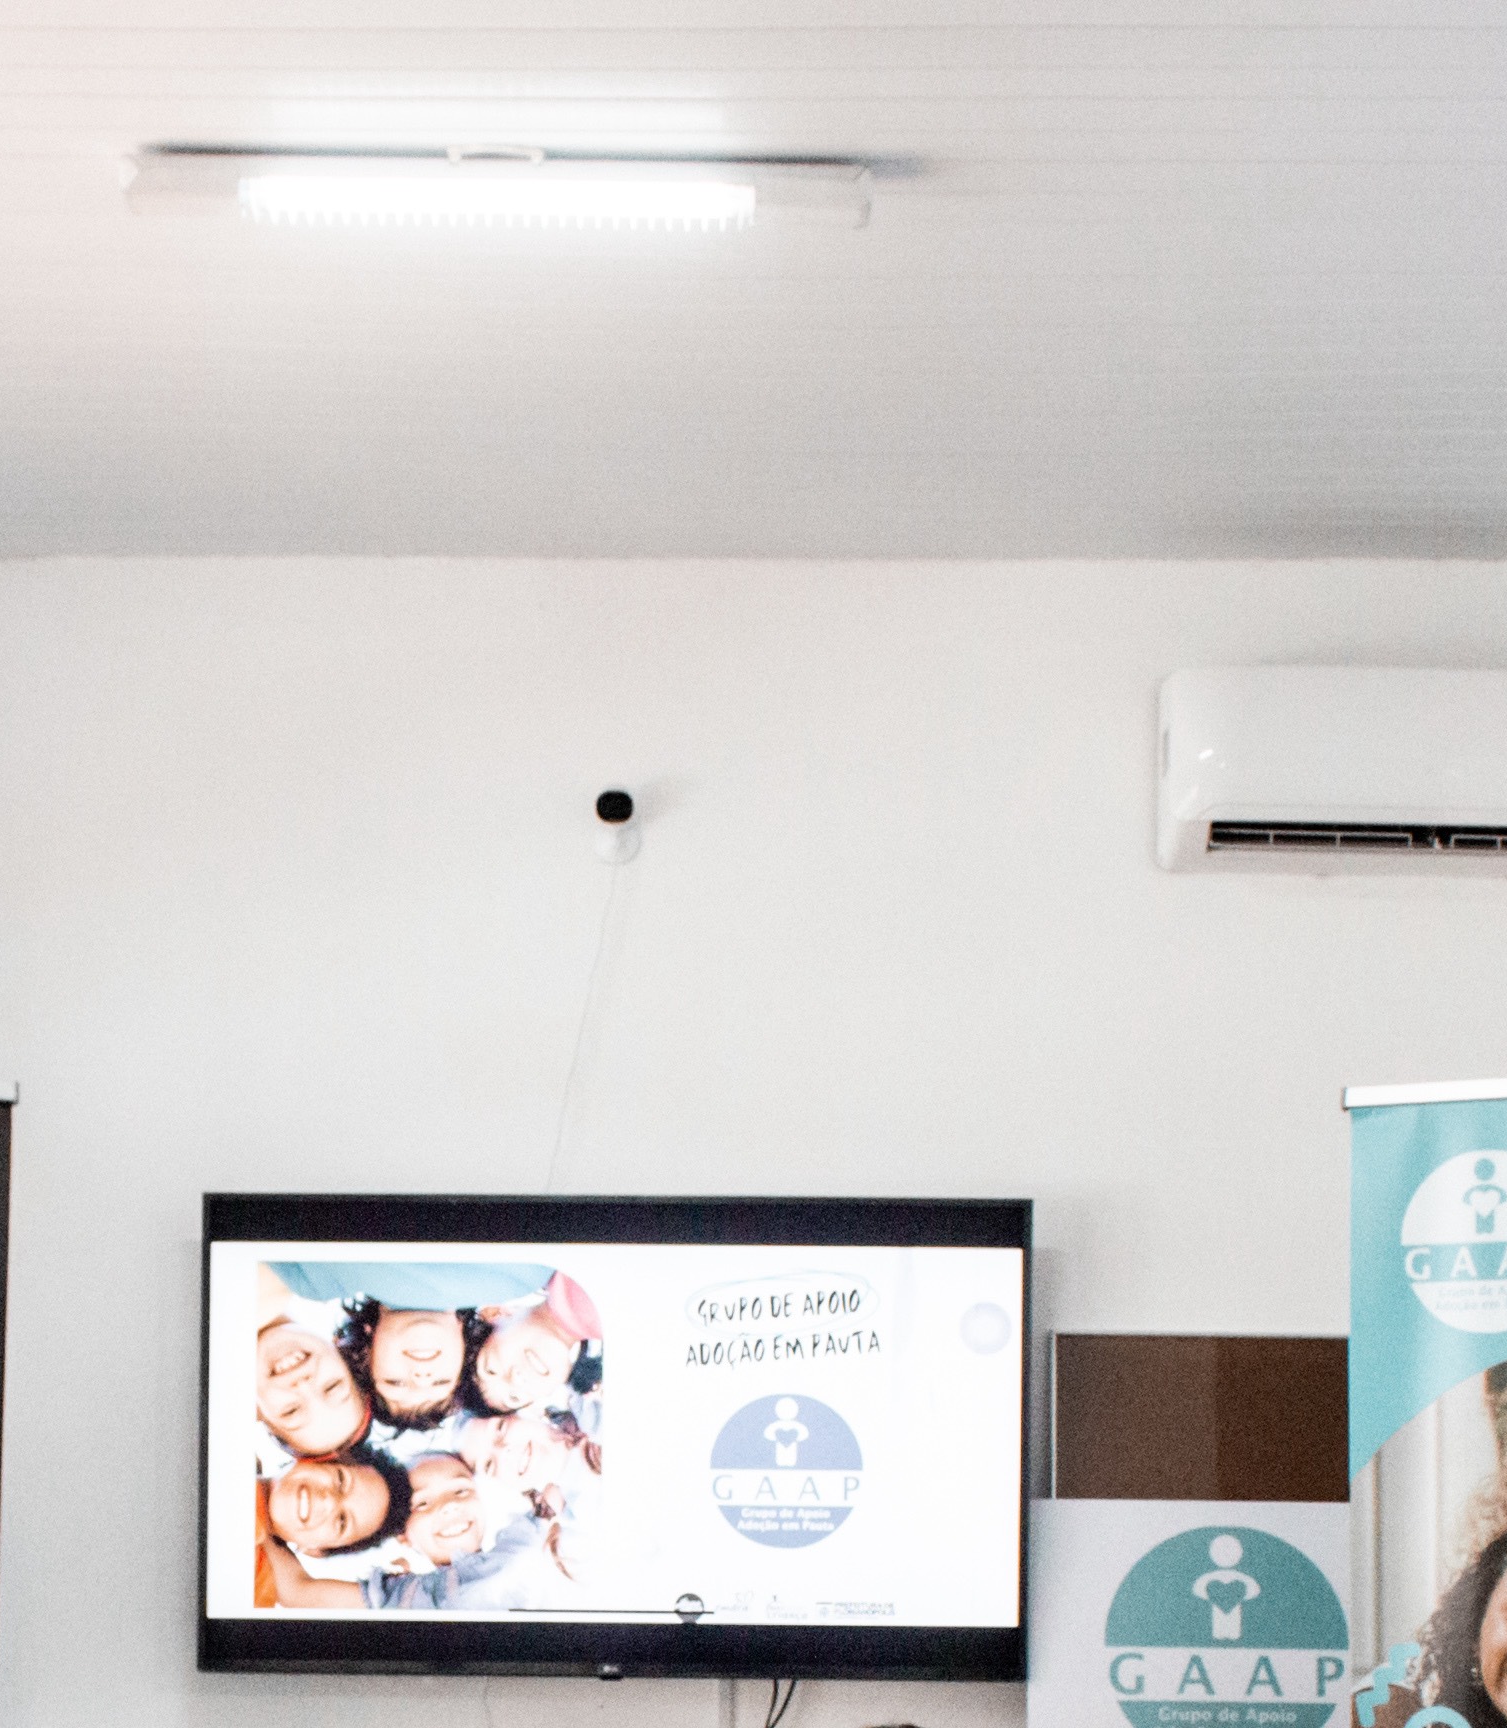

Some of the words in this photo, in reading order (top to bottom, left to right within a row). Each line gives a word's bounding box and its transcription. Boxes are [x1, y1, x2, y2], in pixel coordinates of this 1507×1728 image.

[698, 1297, 762, 1327] GRUPO
[770, 1293, 793, 1318] DE
[802, 1289, 860, 1317] APOIO
[686, 1332, 765, 1370] ADOÇÃO
[773, 1334, 804, 1360] EM
[812, 1330, 880, 1358] PAUTA
[712, 1474, 860, 1501] GAAP
[1108, 1651, 1345, 1698] GAAP
[1157, 1705, 1213, 1724] Grupo
[1218, 1706, 1240, 1721] de
[1245, 1707, 1298, 1725] Apoio
